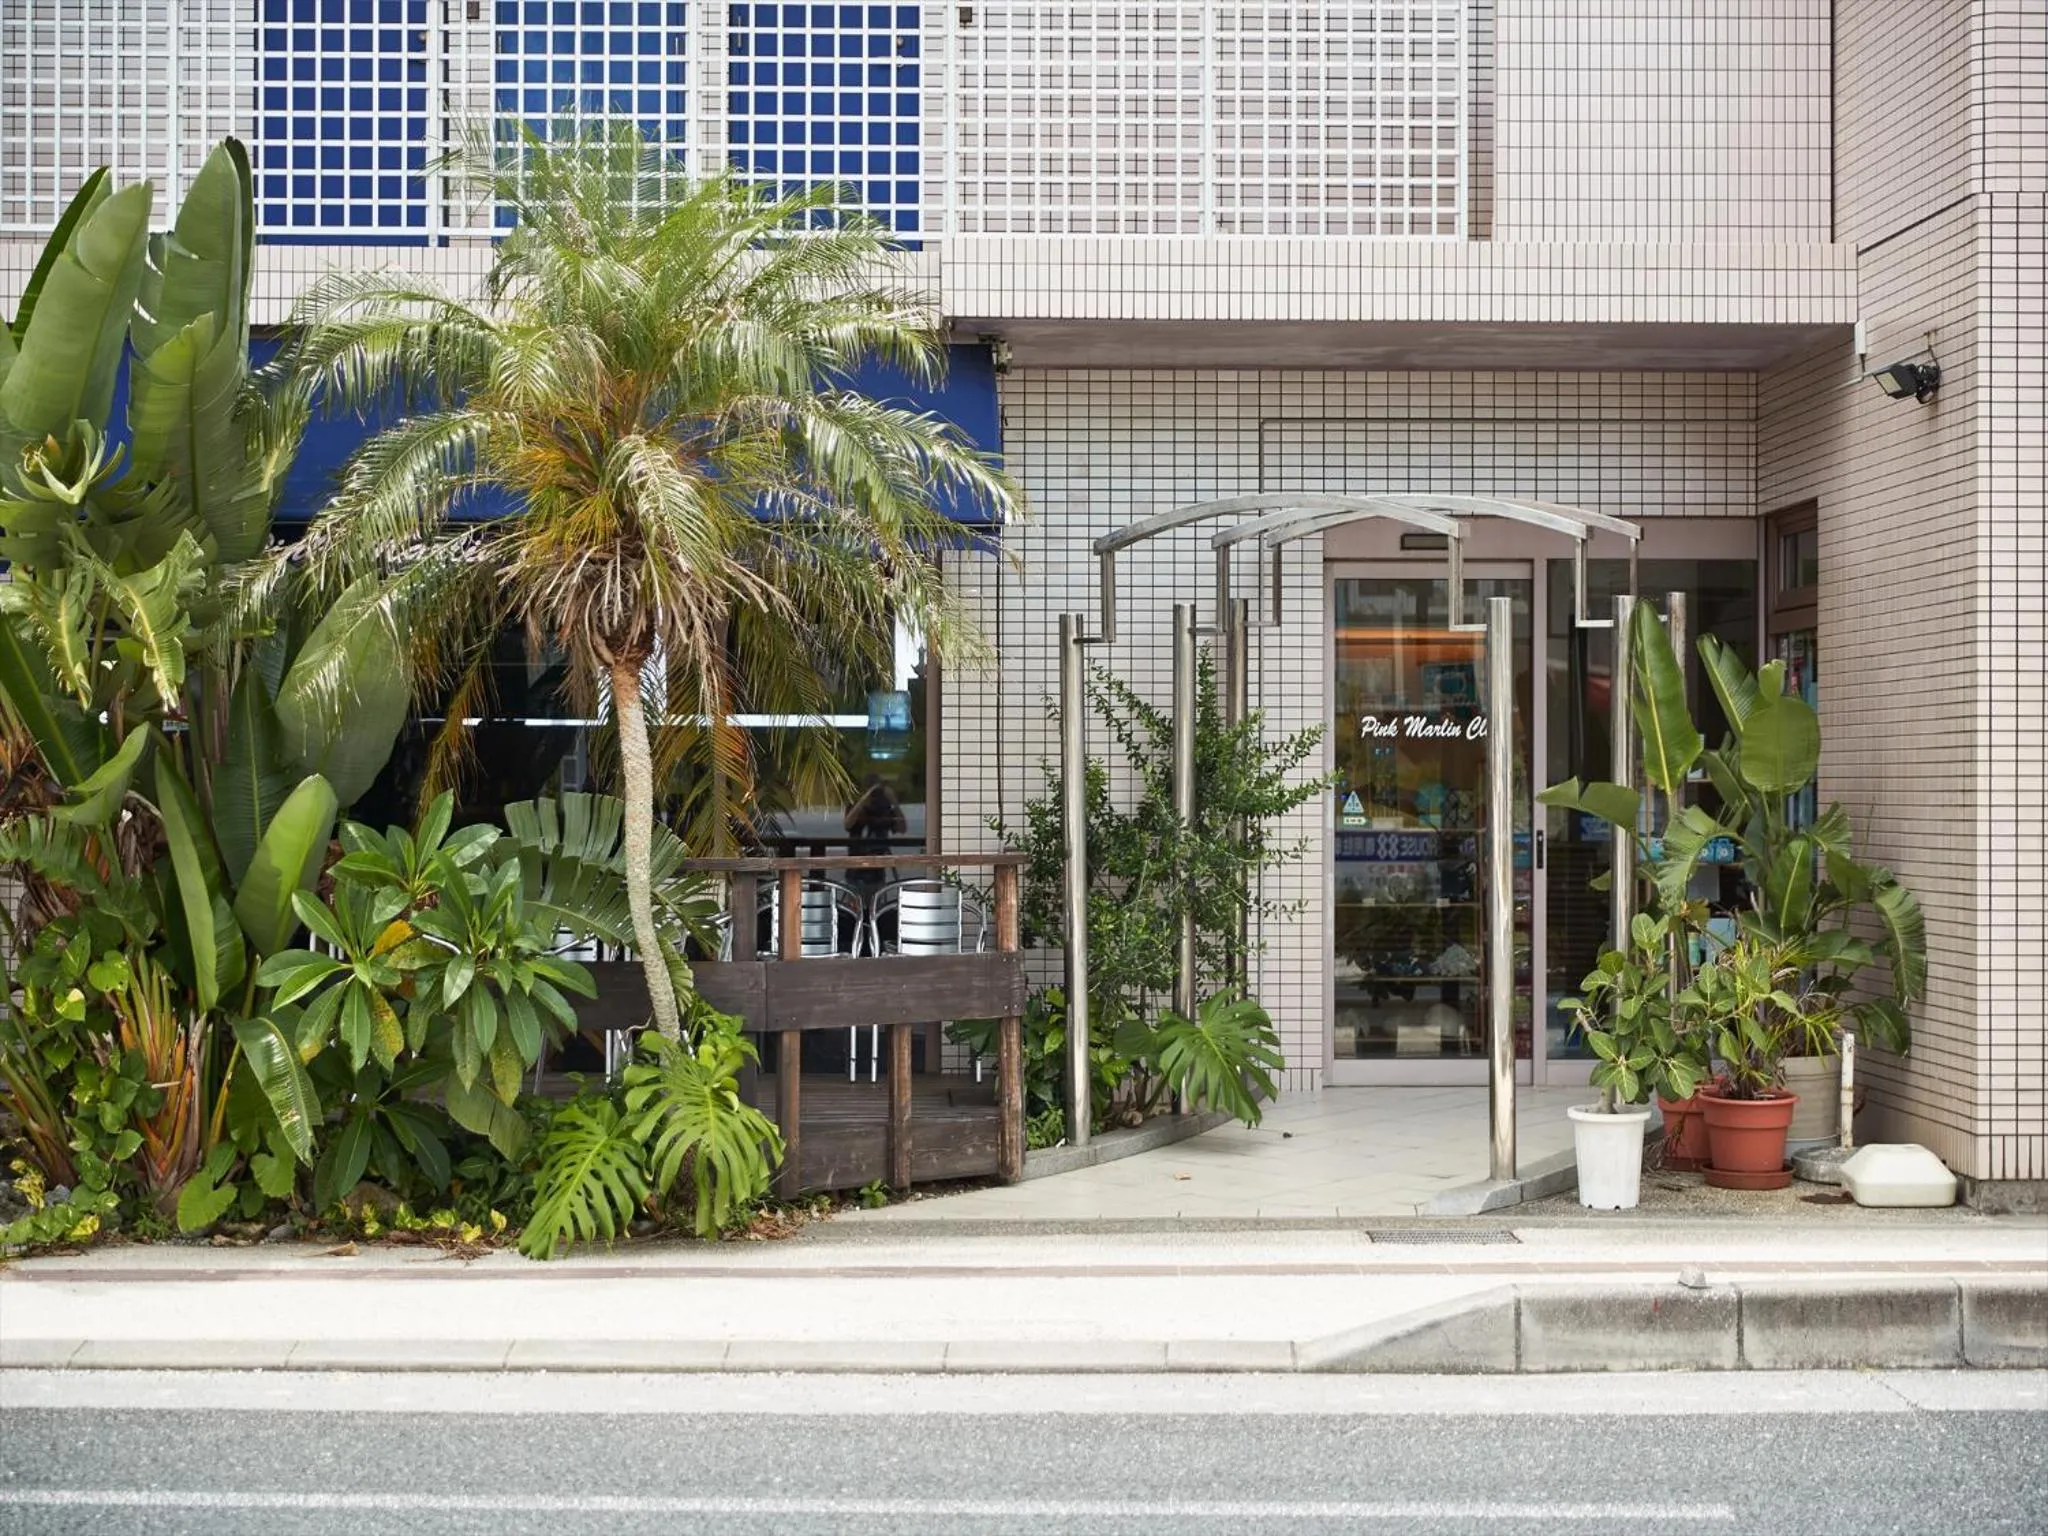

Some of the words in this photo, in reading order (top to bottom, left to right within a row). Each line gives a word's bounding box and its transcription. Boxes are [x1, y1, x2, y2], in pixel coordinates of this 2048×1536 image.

[1361, 716, 1399, 738] Pink
[1403, 716, 1462, 738] Marlin
[1465, 715, 1488, 740] Cl
